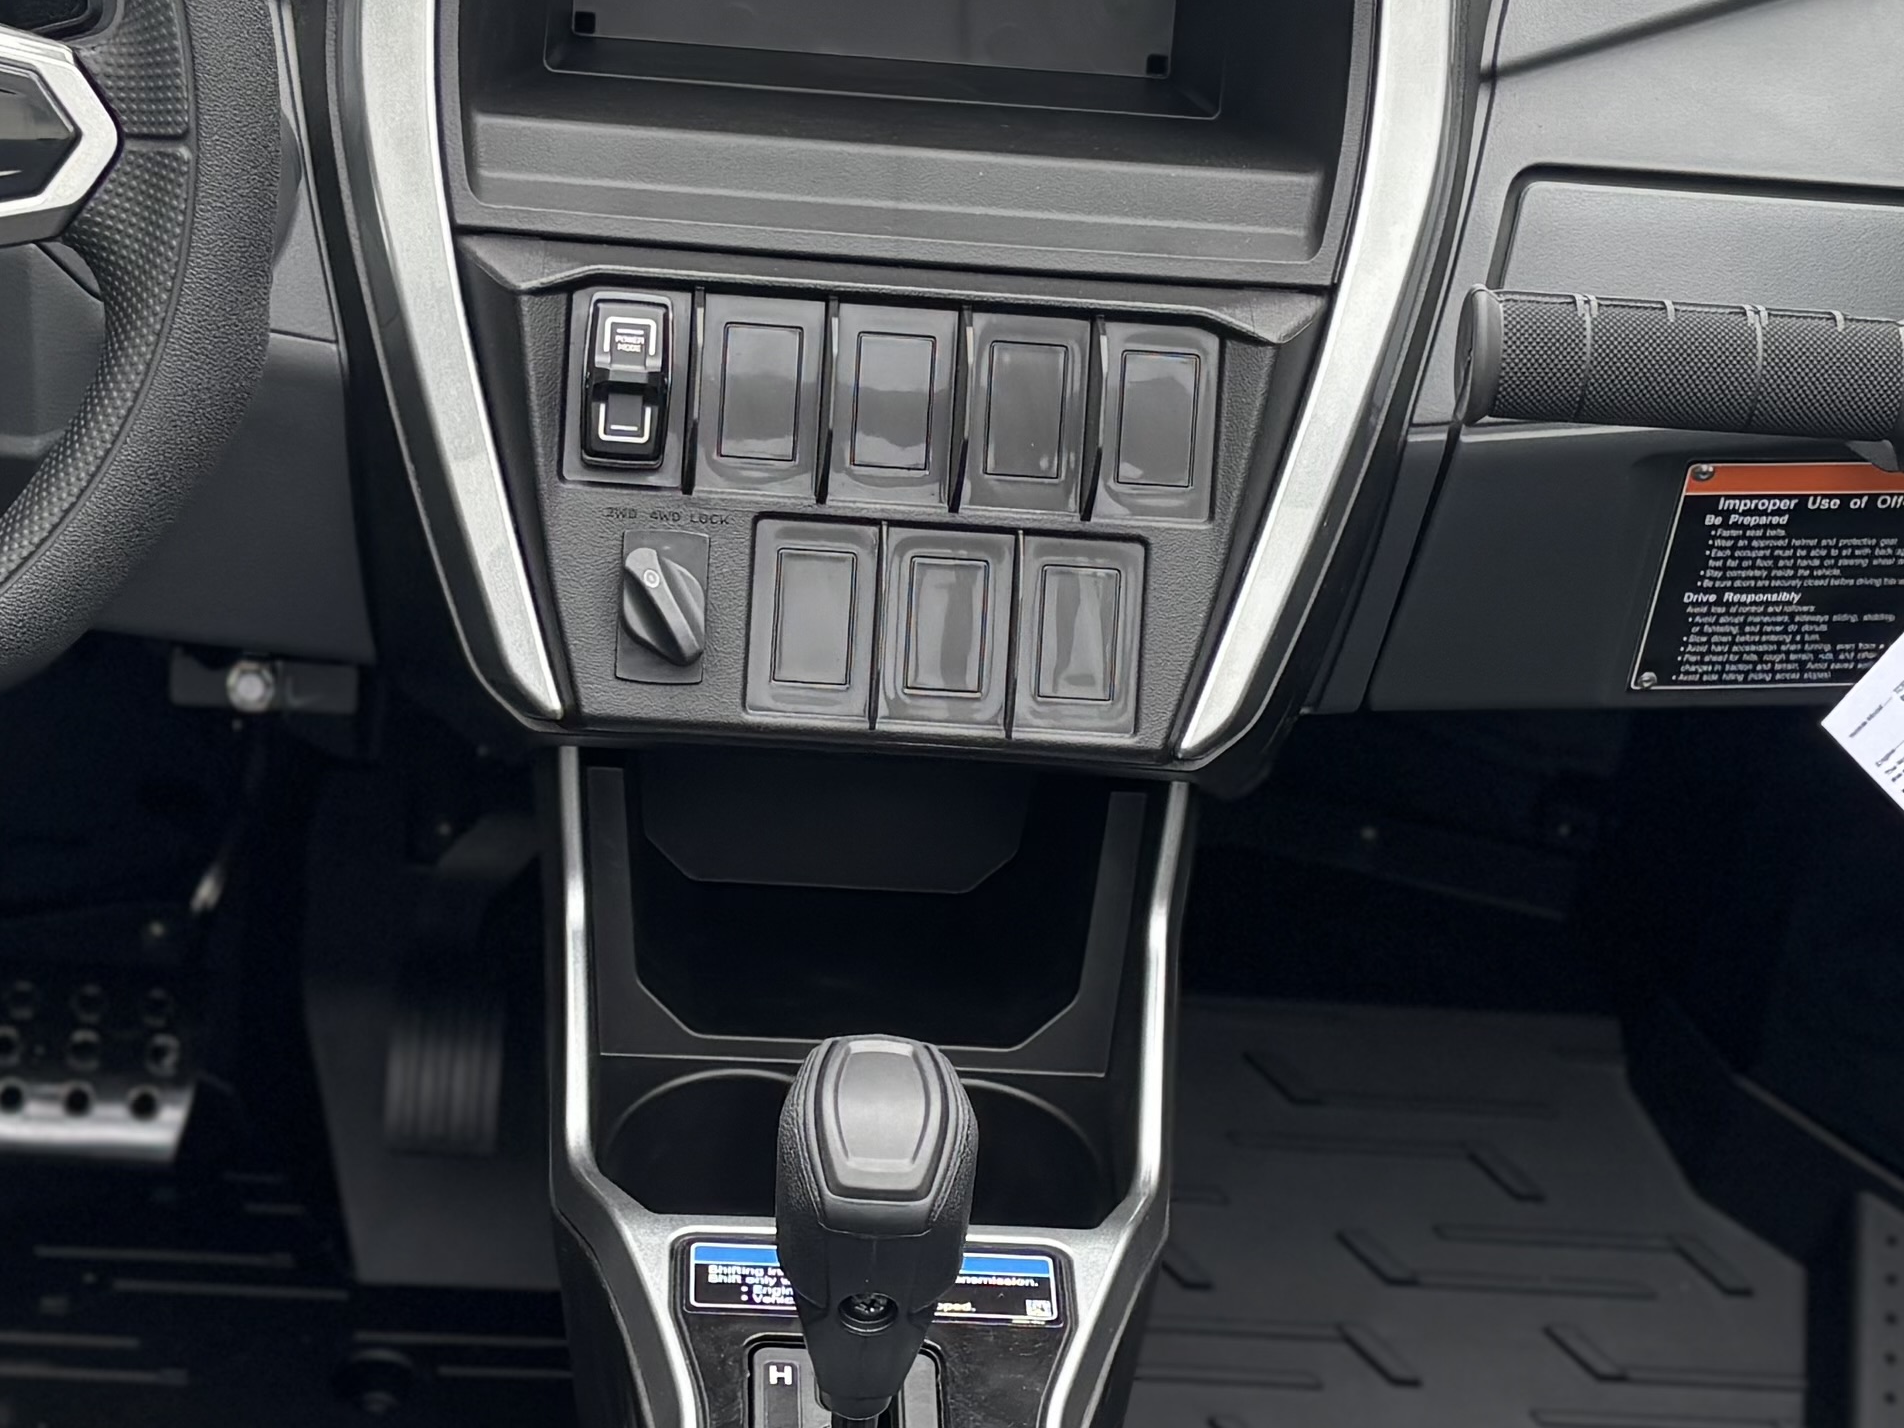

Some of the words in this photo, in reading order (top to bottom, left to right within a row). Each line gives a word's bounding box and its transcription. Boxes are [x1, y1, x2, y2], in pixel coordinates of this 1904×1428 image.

[615, 335, 645, 344] POWER
[617, 343, 642, 353] MODE
[1718, 496, 1798, 513] Improper
[1807, 495, 1840, 510] Use
[1849, 495, 1868, 509] of
[689, 513, 731, 526] LOCK
[1705, 514, 1723, 526] Be
[1729, 514, 1789, 528] Prepared
[1683, 592, 1718, 603] Drive
[1723, 592, 1802, 605] Responsibly
[708, 1264, 764, 1277] Shifting
[708, 1273, 742, 1284] Shift
[745, 1275, 777, 1287] only
[752, 1284, 794, 1297] Engin
[752, 1293, 796, 1305] Vehic
[768, 1365, 793, 1386] H
